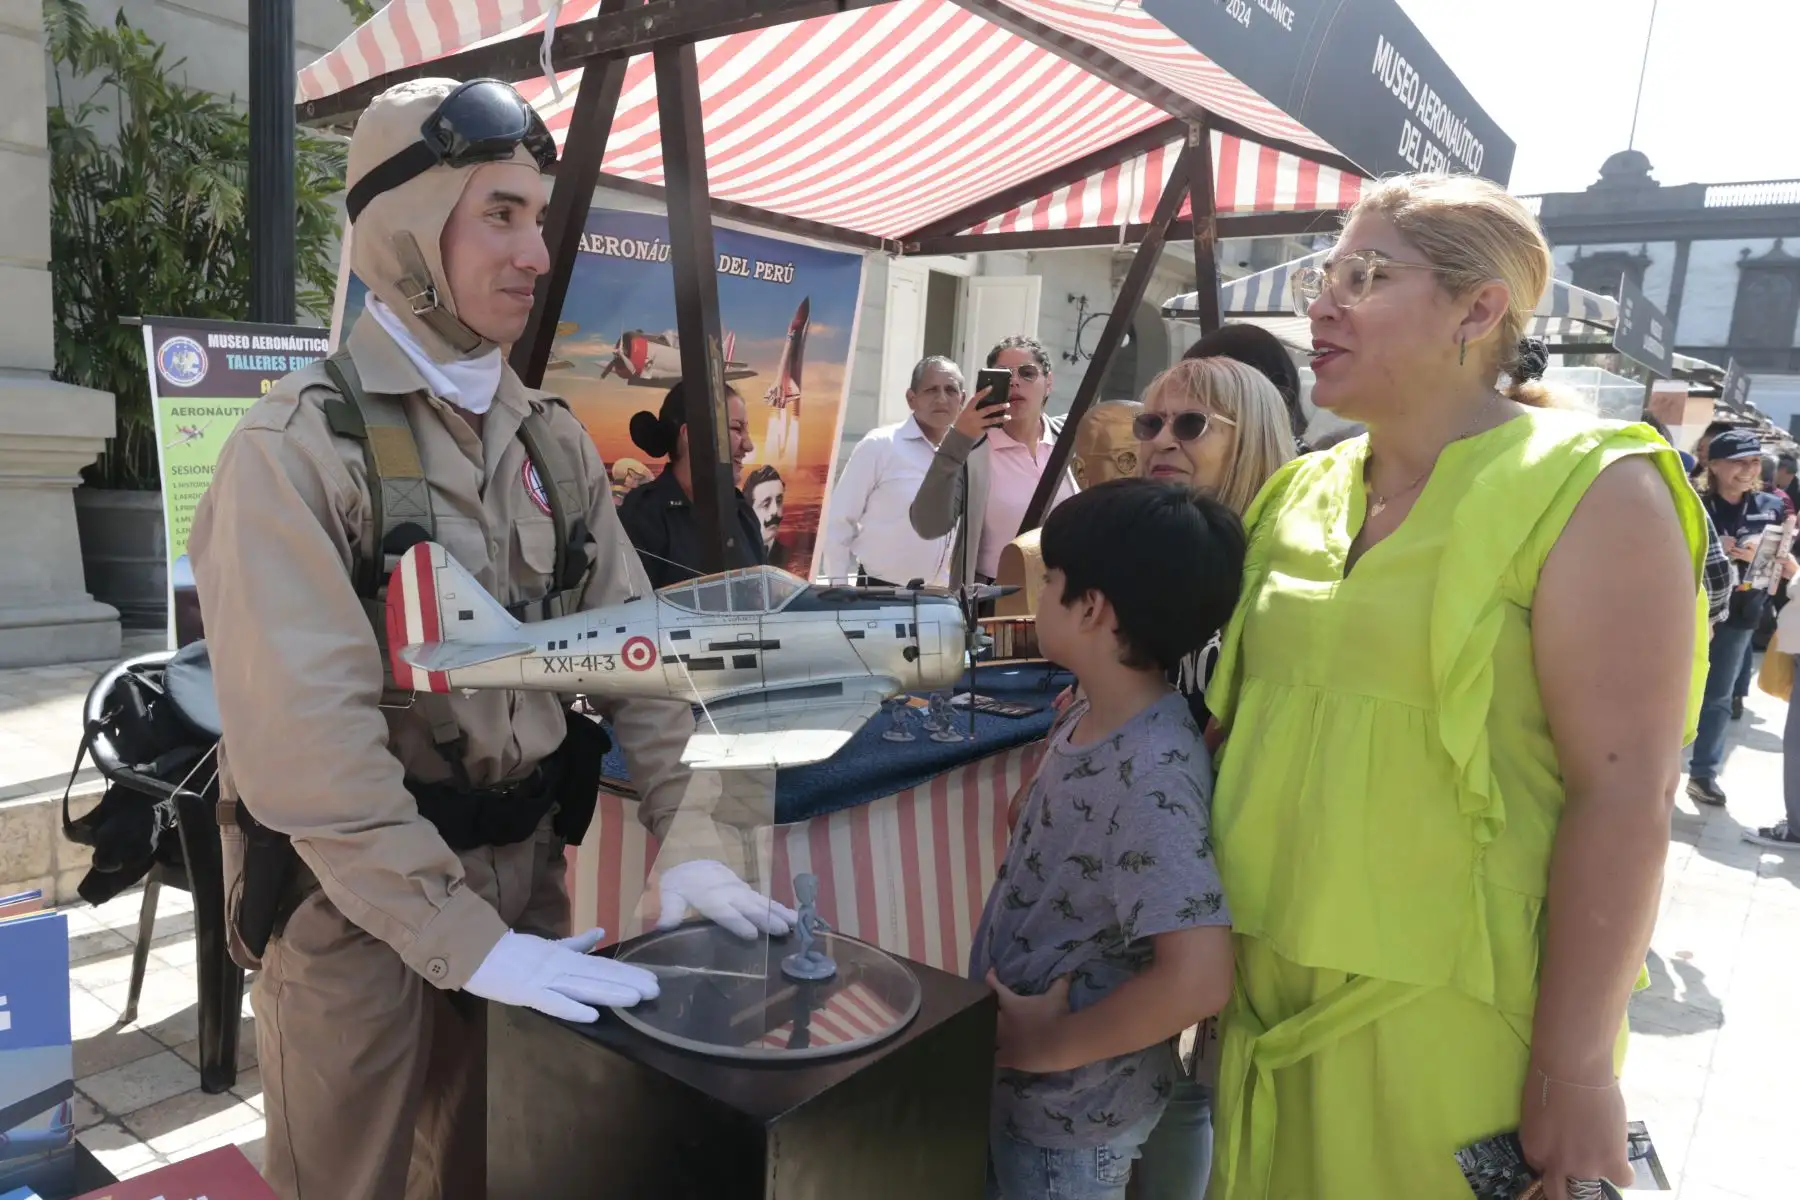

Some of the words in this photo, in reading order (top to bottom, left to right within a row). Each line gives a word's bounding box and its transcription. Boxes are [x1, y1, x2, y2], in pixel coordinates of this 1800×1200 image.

[1372, 34, 1420, 110] MUSEO
[1398, 118, 1422, 169] DEL
[717, 254, 750, 277] DEL
[753, 261, 795, 284] PERÚ
[208, 333, 250, 350] MUSEO
[252, 335, 329, 352] AERONÁUTICO
[226, 353, 287, 371] TALLERES
